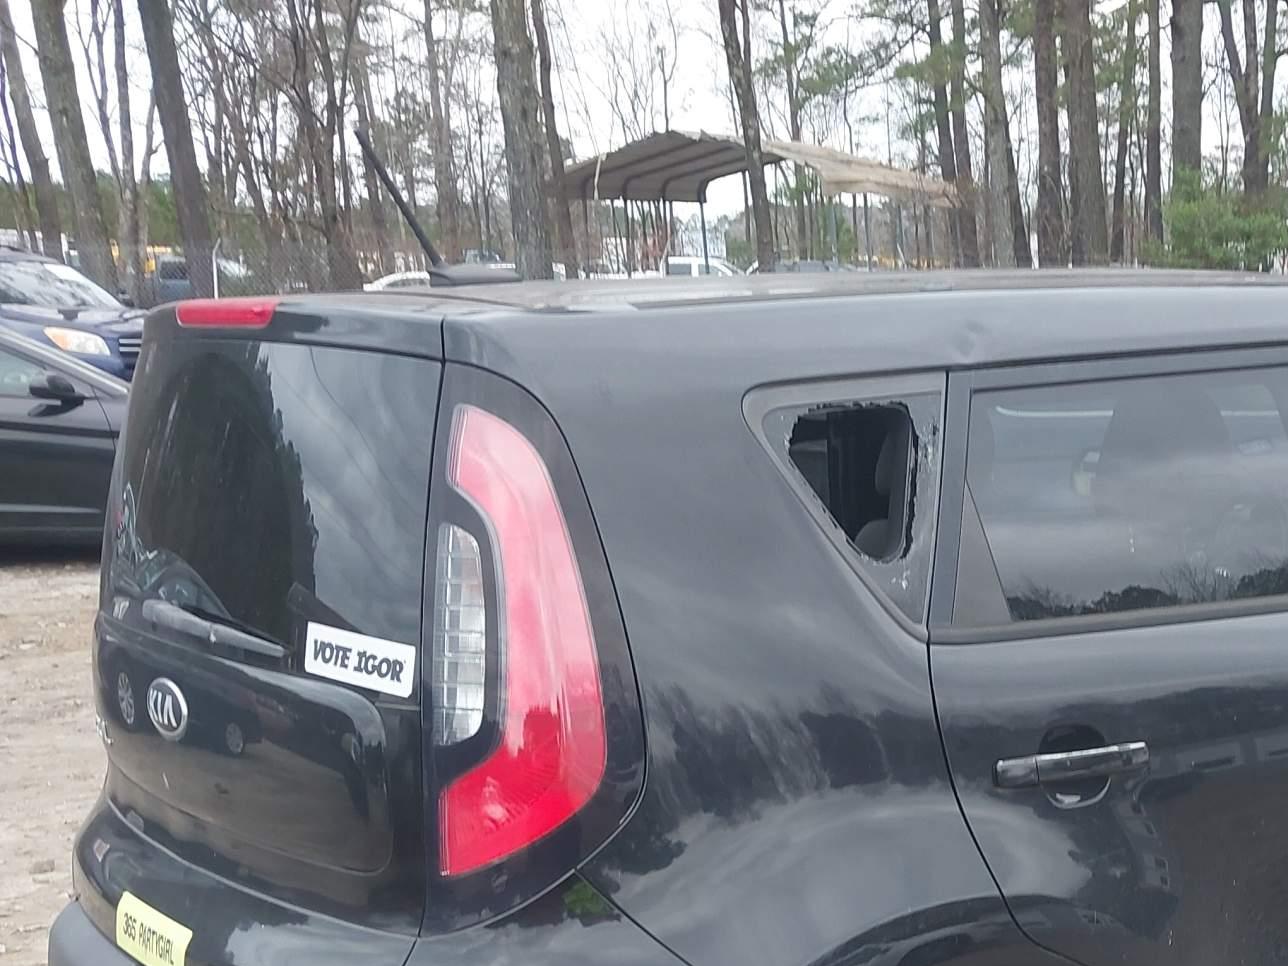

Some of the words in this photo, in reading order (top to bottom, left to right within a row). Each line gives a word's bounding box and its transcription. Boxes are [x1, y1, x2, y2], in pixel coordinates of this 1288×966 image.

[314, 638, 352, 669] VOTE
[353, 650, 404, 683] IGOR
[147, 687, 178, 729] KIA
[122, 912, 137, 941] 365
[138, 921, 175, 965] PARTYGIRL
